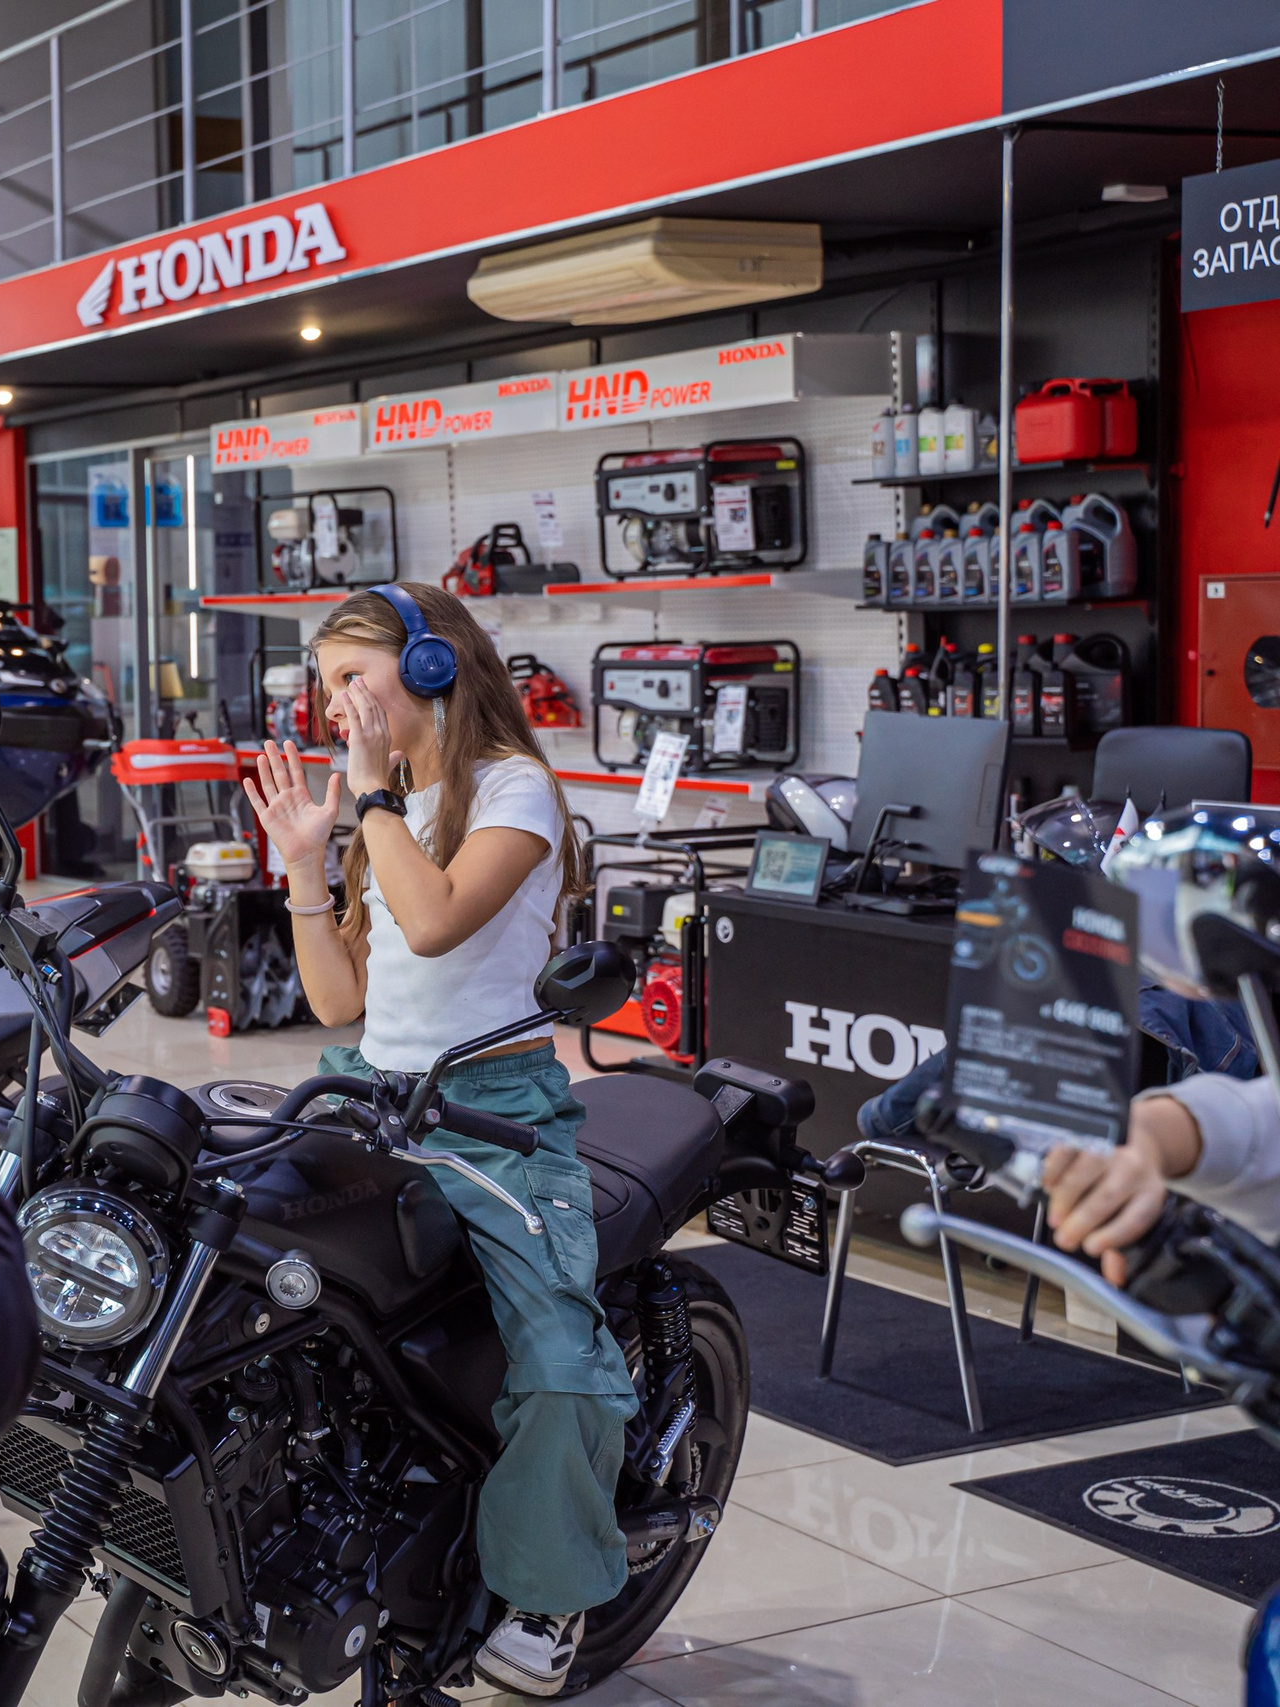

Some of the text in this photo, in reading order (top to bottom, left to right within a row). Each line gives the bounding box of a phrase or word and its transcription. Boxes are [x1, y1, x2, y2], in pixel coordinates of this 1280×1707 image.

[118, 202, 346, 315] HONDA
[718, 342, 786, 366] HONDA
[497, 378, 552, 397] HONDA
[566, 370, 712, 421] HND POWER
[375, 399, 493, 443] HND POWER
[216, 425, 310, 464] HND POWER
[420, 654, 445, 672] JBL
[281, 1178, 381, 1221] HONDA
